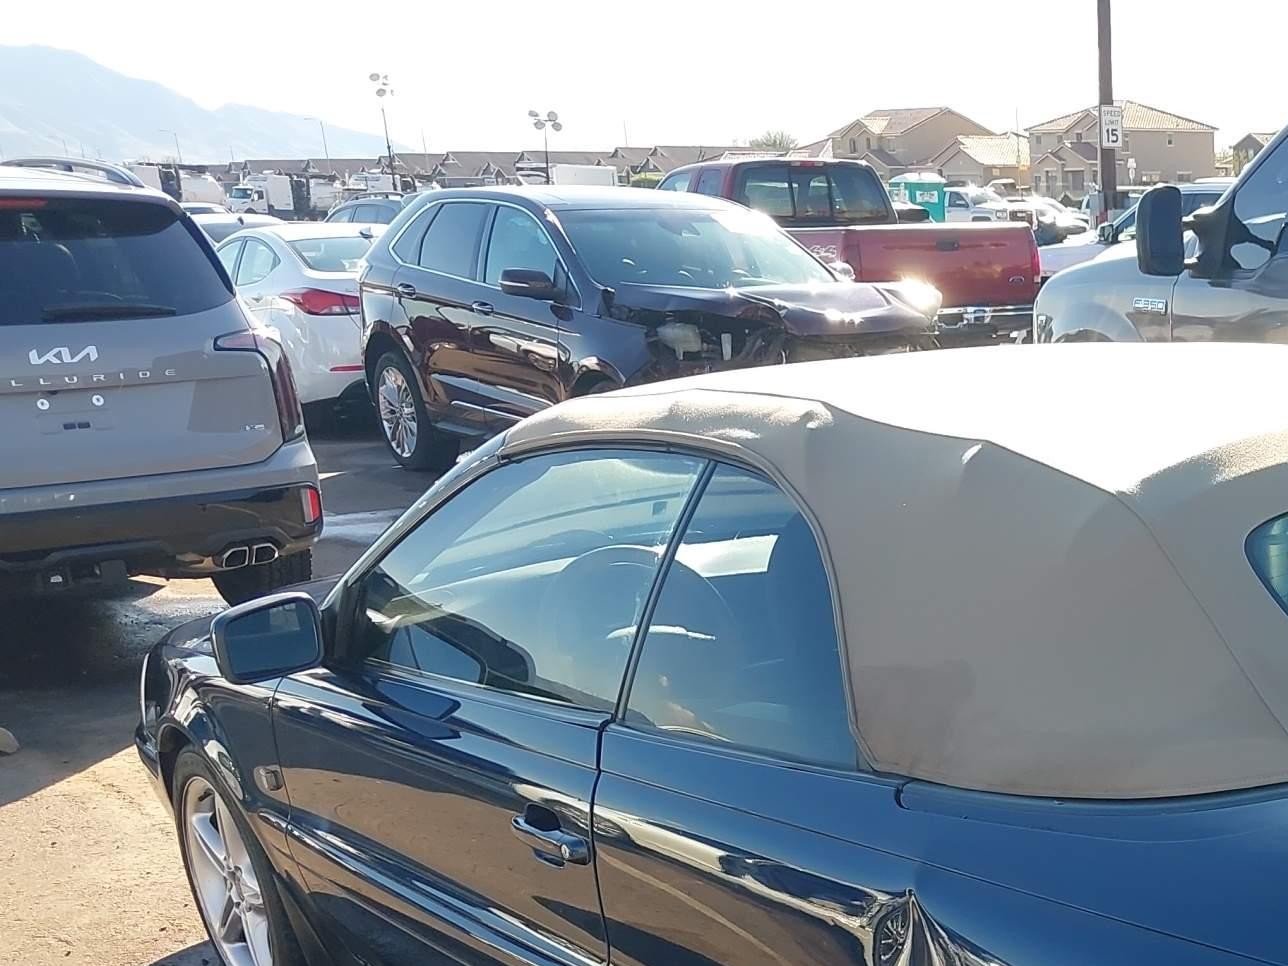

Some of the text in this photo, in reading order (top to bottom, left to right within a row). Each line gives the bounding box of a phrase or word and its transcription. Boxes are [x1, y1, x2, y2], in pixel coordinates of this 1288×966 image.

[1103, 110, 1120, 118] SPEED
[1105, 128, 1119, 143] 15
[28, 345, 99, 365] KIA
